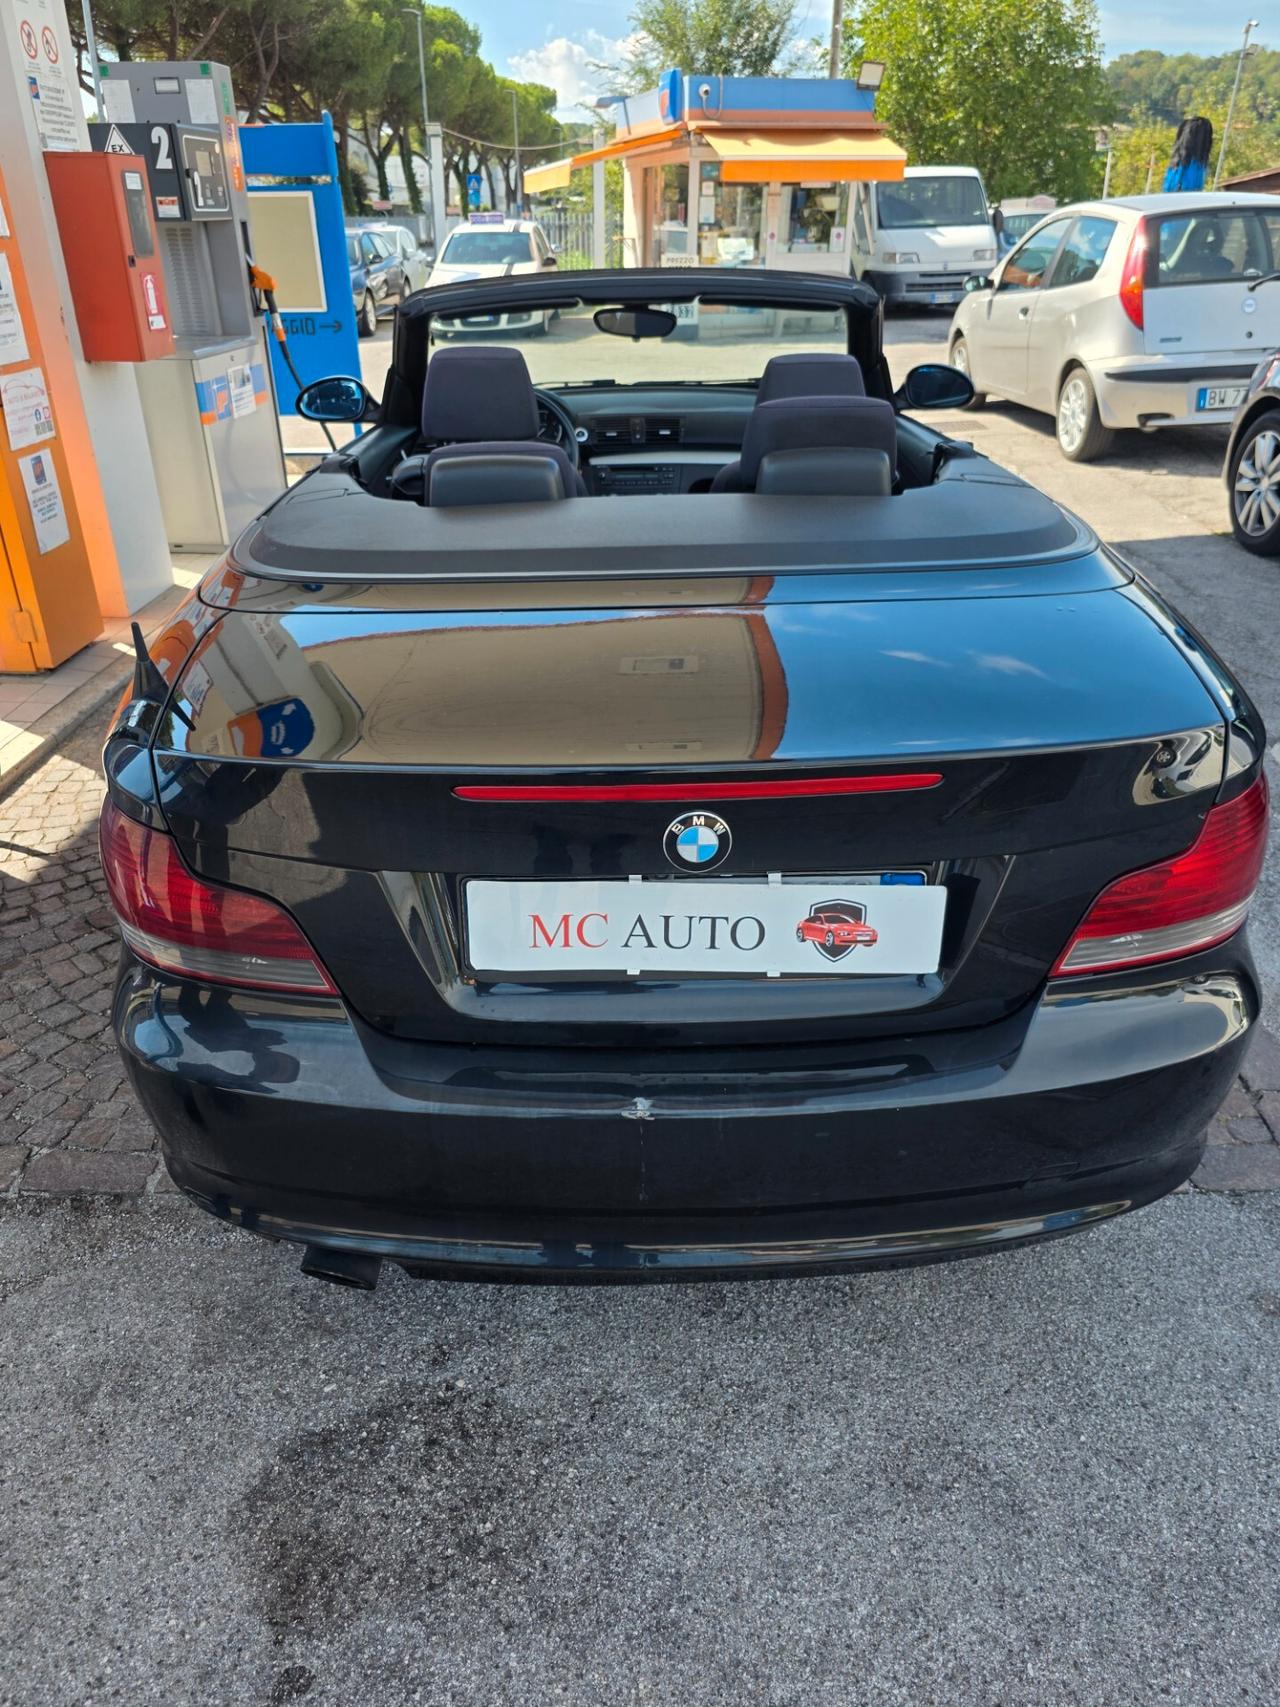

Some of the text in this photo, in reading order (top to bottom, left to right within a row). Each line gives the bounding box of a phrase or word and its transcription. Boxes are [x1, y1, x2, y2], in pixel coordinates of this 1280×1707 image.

[111, 144, 125, 153] EX
[151, 127, 173, 169] 2
[1209, 390, 1226, 406] BW
[671, 815, 727, 836] BMW
[529, 913, 767, 951] MC AUTO
